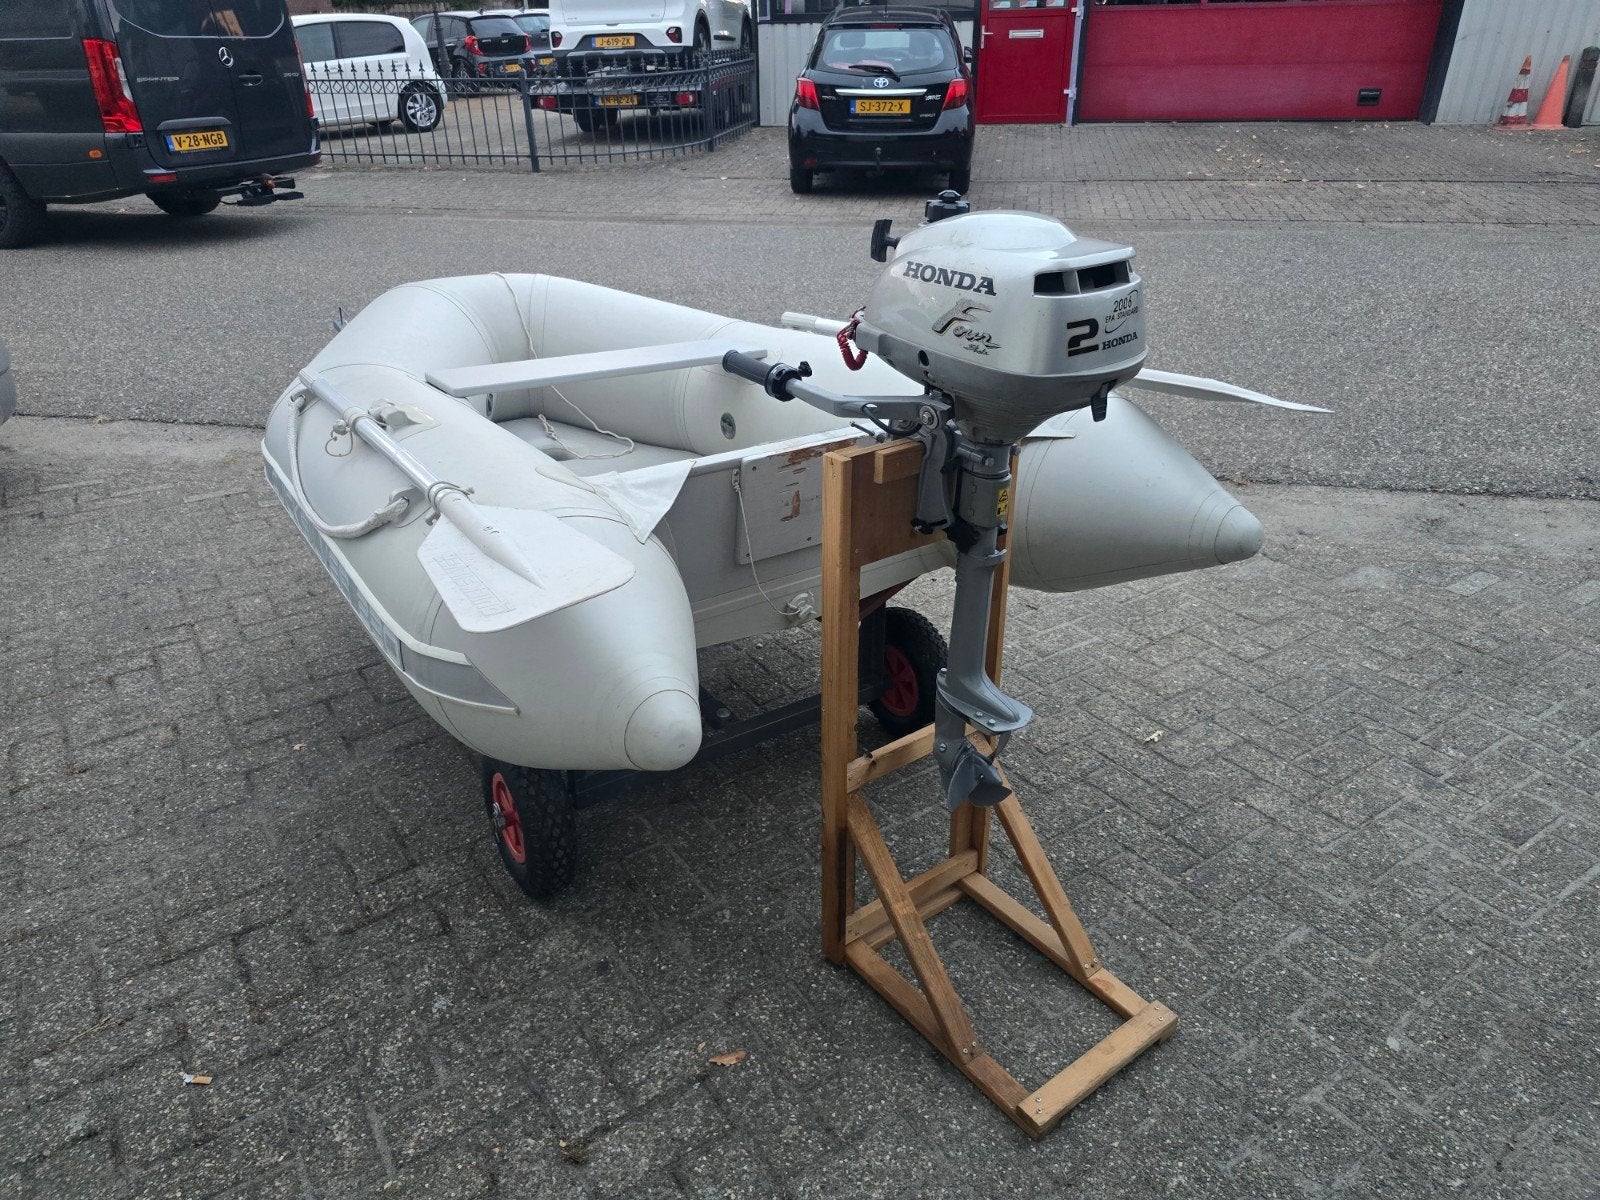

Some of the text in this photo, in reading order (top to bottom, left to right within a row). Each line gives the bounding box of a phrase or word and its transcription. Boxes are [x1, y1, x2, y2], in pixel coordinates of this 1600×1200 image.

[599, 36, 632, 46] J-619-ZK
[859, 101, 904, 112] SJ-372-X
[174, 132, 224, 149] V-28-NGB
[903, 260, 997, 297] HONDA
[1113, 296, 1133, 313] 2006
[1066, 318, 1099, 357] 2
[1102, 332, 1138, 351] HONDA
